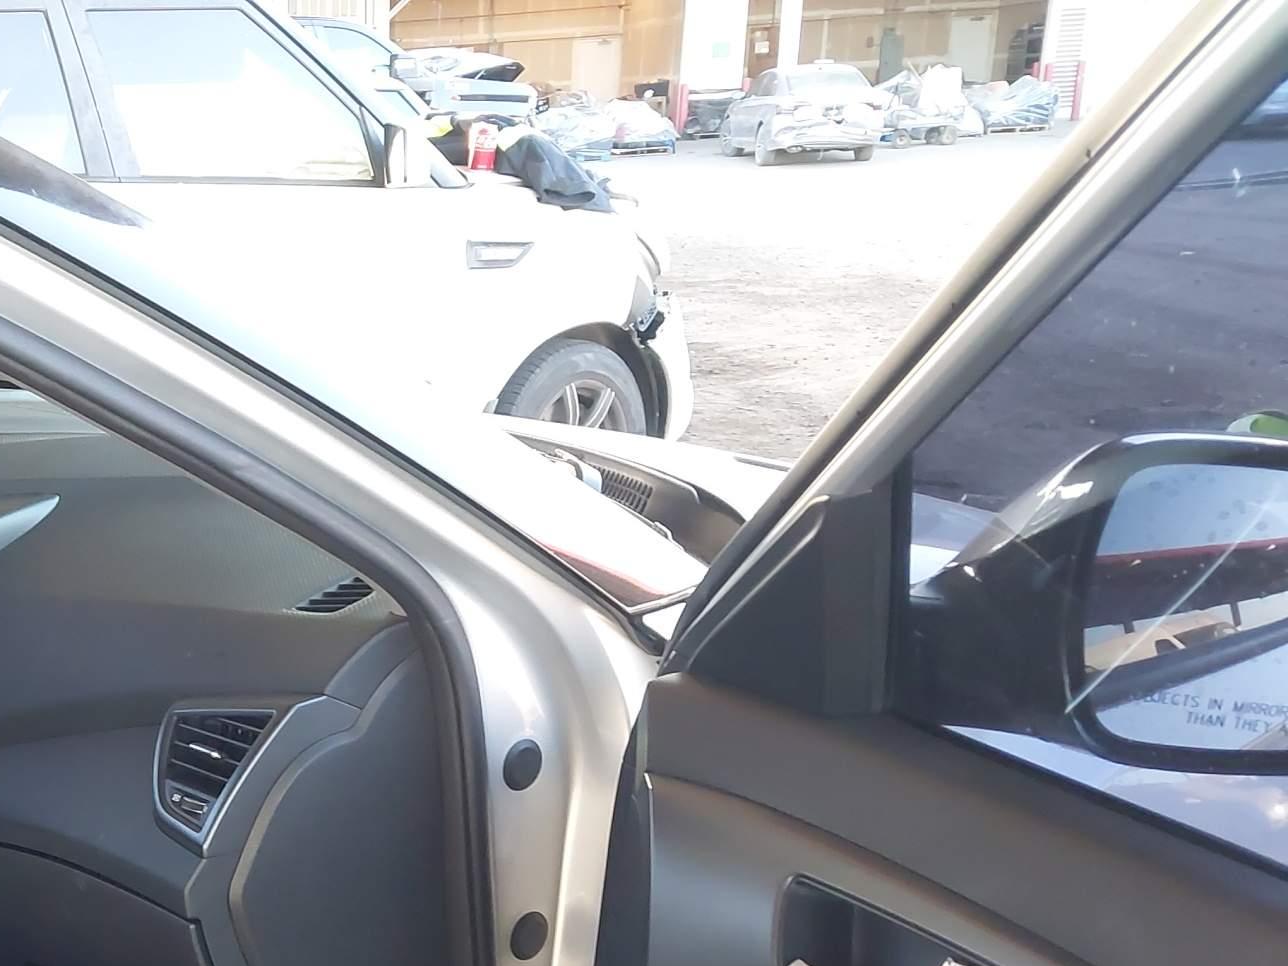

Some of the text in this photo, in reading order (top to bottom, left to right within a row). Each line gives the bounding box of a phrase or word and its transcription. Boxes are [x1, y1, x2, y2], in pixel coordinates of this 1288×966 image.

[1207, 697, 1224, 711] IN
[1186, 711, 1227, 728] THAN
[1234, 717, 1272, 734] THEY
